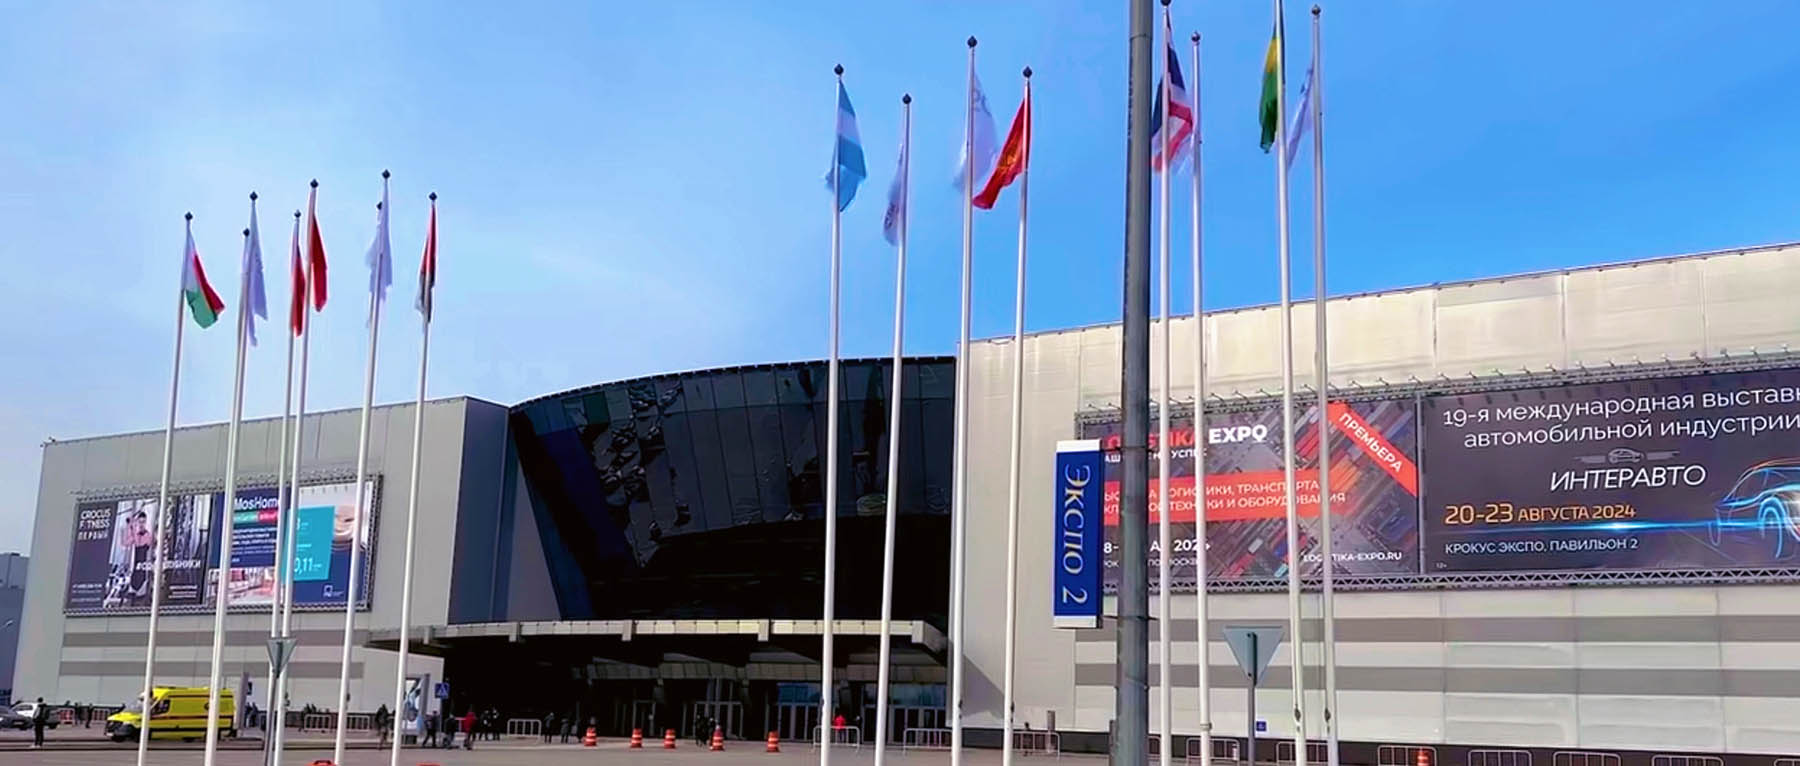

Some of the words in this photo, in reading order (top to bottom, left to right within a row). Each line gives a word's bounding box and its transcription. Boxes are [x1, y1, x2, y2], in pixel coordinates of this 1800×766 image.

[1443, 408, 1488, 427] 19-я
[1496, 394, 1695, 422] международная
[1208, 424, 1268, 444] EXPO
[1464, 419, 1652, 447] автомобильной
[1660, 414, 1800, 439] индустрии
[1339, 412, 1402, 473] ПРЕМЬЕРА
[1238, 480, 1319, 494] ТРАНСПРТА
[1551, 465, 1706, 491] ИНТЕРАВТО
[234, 496, 281, 510] MosHom
[1170, 498, 1223, 512] ТЕХНКИ
[1445, 503, 1513, 525] 20-23
[1518, 507, 1589, 521] АВГУСТА
[1592, 505, 1635, 519] 2024
[1445, 542, 1496, 554] КРОКУС
[1550, 539, 1626, 551] ПАВИЛЬОН
[1630, 538, 1639, 549] 2
[1062, 587, 1088, 604] 2
